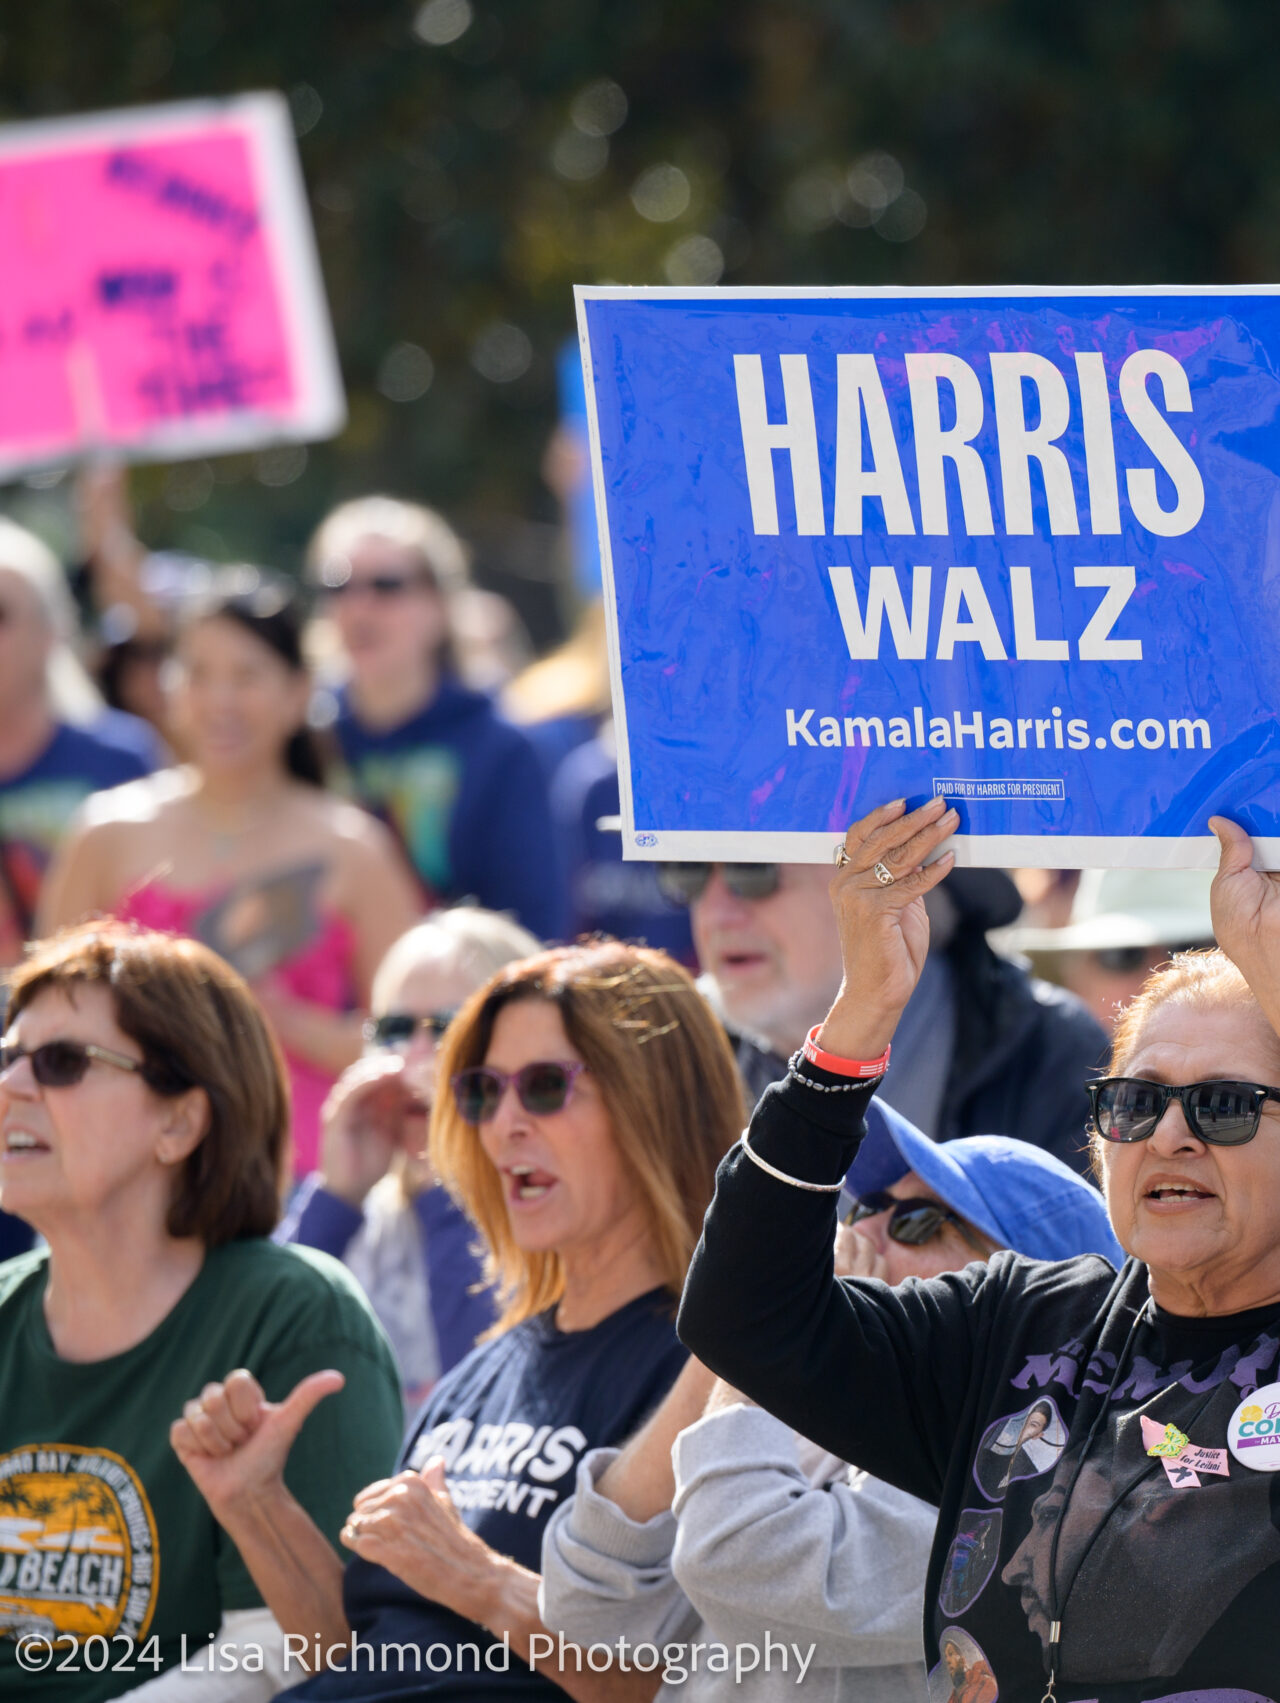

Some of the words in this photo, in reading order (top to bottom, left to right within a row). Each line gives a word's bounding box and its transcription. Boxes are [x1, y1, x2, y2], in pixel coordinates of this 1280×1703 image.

[733, 347, 1206, 537] HARRIS
[827, 565, 1143, 661] WALZ
[785, 705, 1212, 750] KamalaHarris.com
[936, 782, 954, 794] PAID
[954, 783, 966, 794] FOR
[966, 783, 975, 795] BY
[976, 783, 1006, 796] HARRIS
[1007, 783, 1021, 795] FOR
[1022, 783, 1060, 796] PRESIDENT
[1180, 1454, 1194, 1465] for
[1194, 1459, 1222, 1471] Leilani
[1194, 1449, 1221, 1459] Justice
[18, 1550, 124, 1598] BEACH
